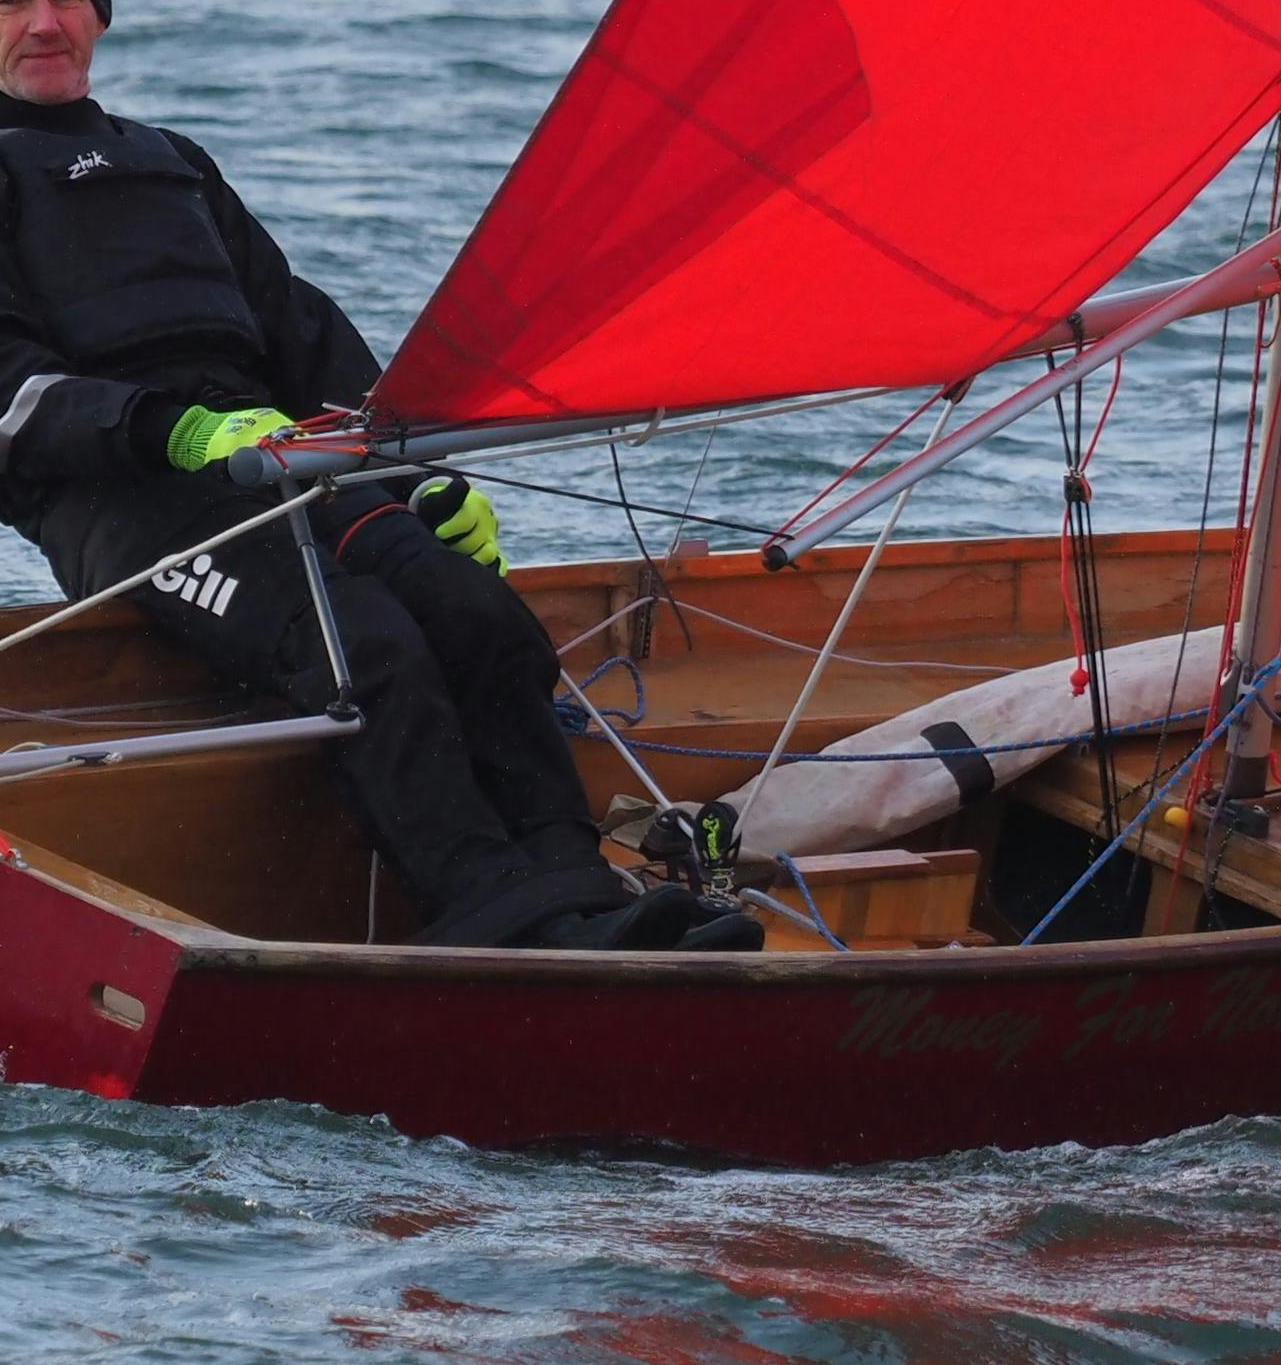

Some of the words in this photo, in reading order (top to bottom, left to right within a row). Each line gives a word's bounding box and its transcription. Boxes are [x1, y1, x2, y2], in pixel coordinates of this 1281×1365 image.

[67, 150, 110, 179] zhik
[151, 553, 239, 617] Gill
[1062, 972, 1176, 1061] For
